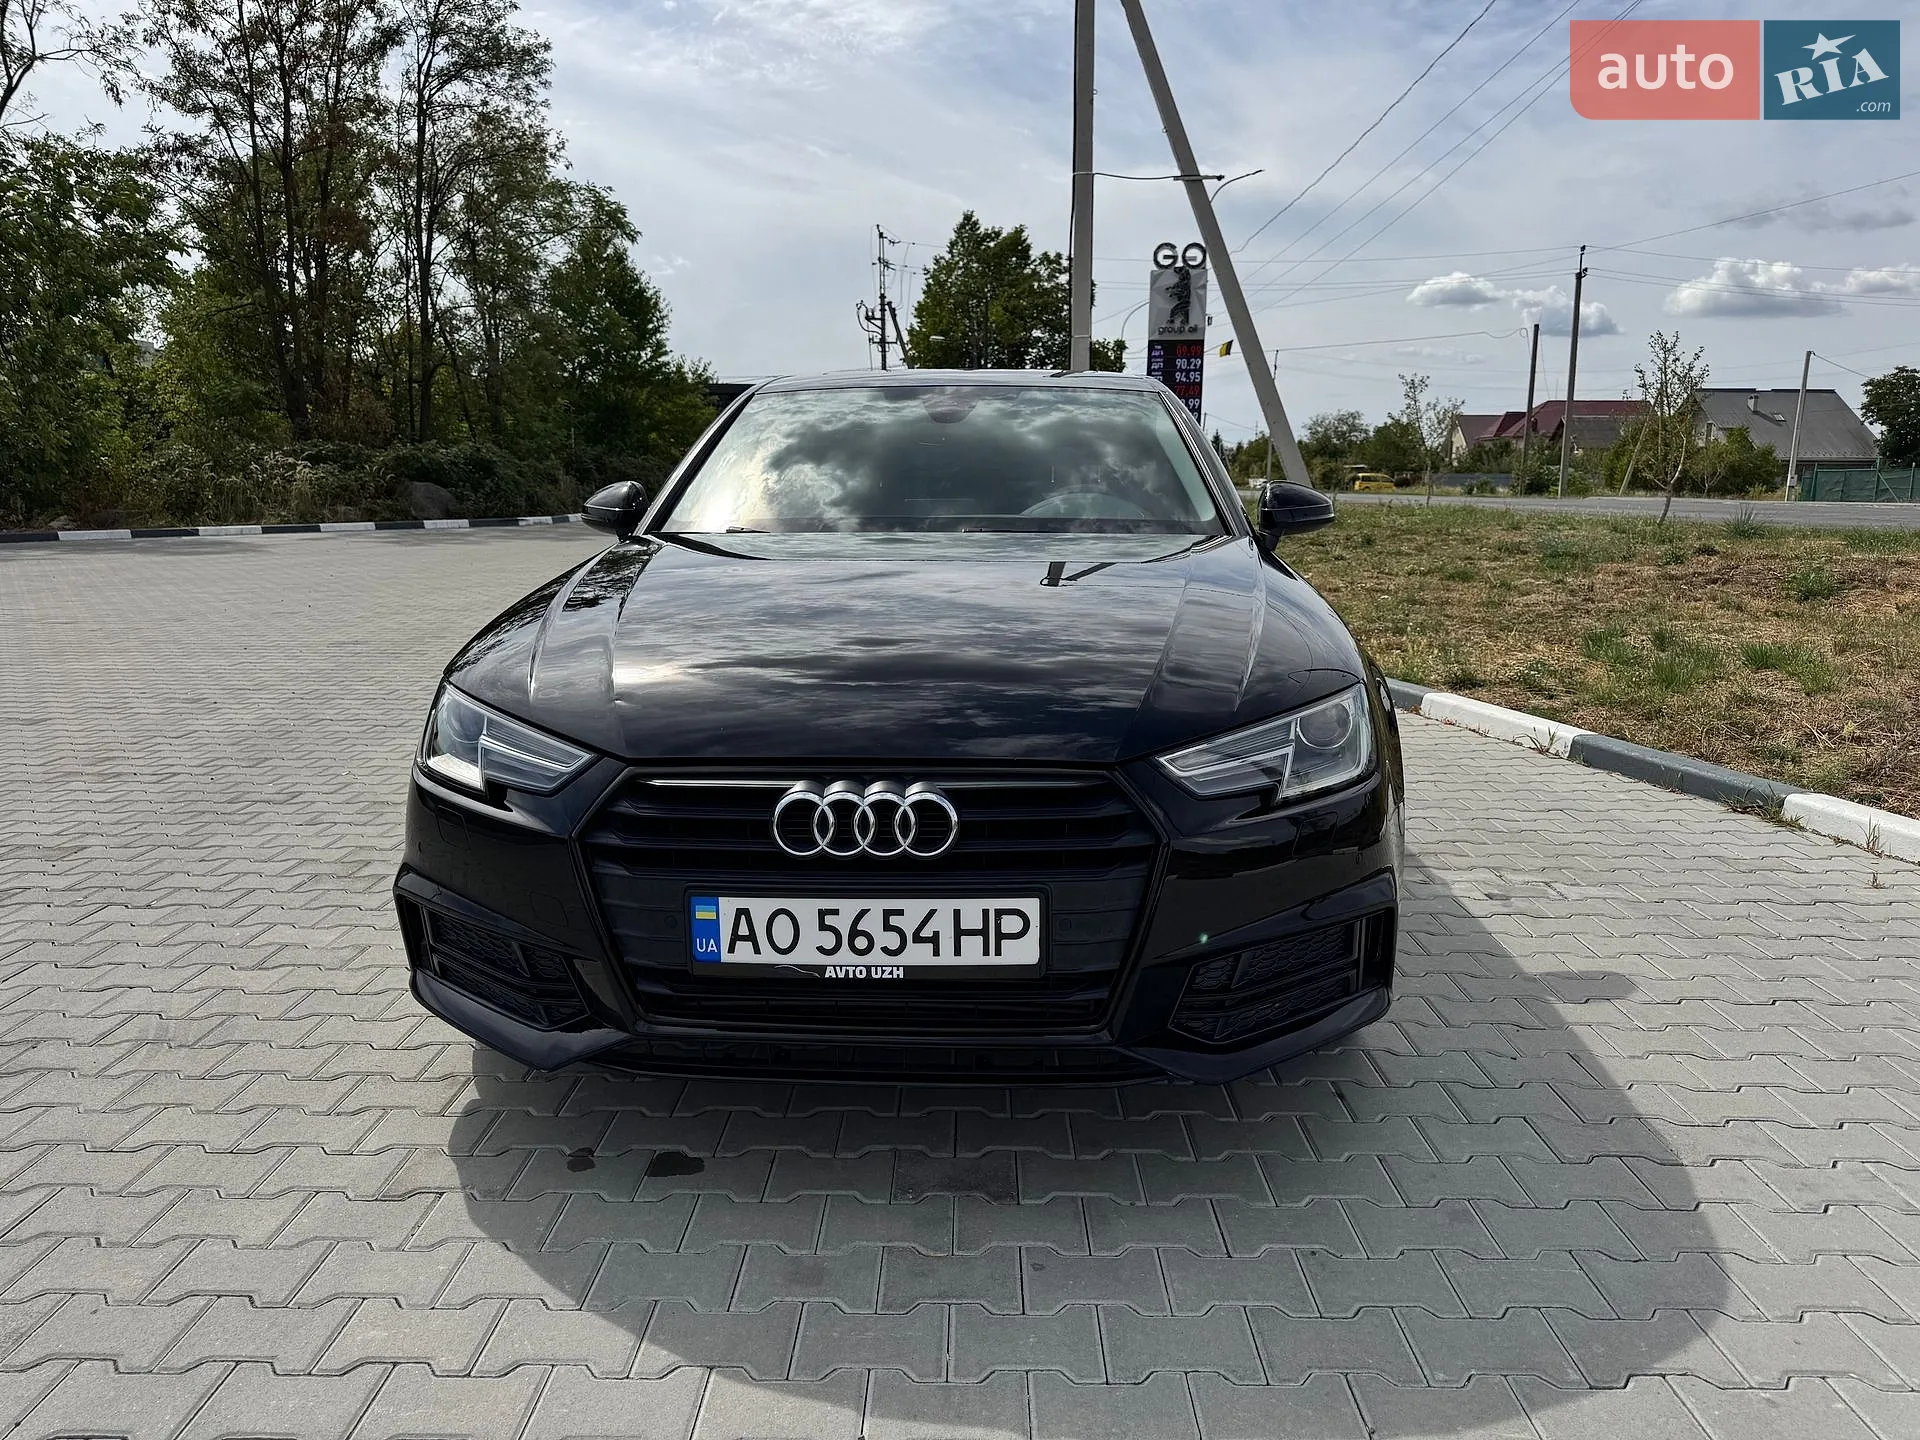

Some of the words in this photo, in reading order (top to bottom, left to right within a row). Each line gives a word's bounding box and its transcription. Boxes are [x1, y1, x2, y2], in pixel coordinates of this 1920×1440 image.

[1158, 326, 1185, 335] group
[1175, 358, 1202, 369] 90.29
[1175, 371, 1201, 382] 94.95
[727, 907, 801, 956] AO
[815, 908, 941, 957] 5654
[952, 908, 1031, 957] HP
[696, 938, 718, 953] UA
[824, 966, 867, 979] AVTO
[871, 966, 904, 979] UZH
